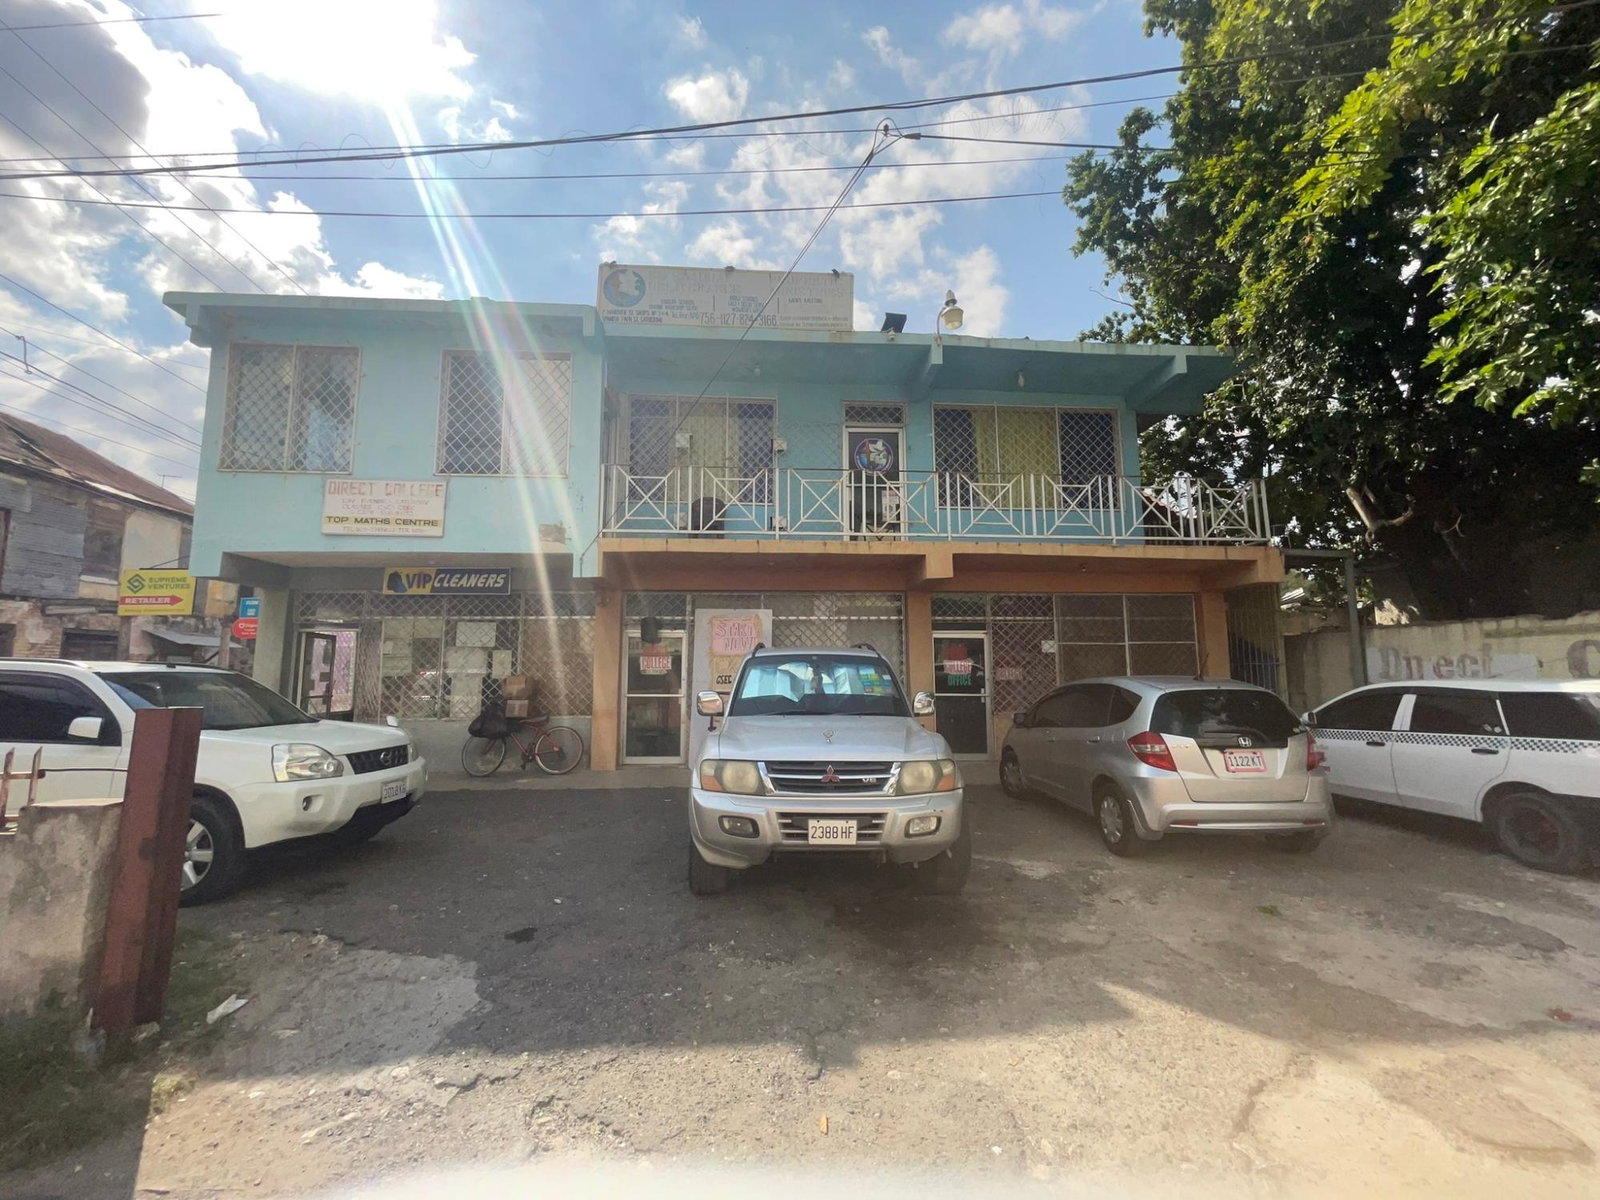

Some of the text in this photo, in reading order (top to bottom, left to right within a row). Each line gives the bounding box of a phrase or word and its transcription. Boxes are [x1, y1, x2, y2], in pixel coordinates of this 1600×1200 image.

[739, 313, 777, 327] 8243166
[327, 481, 376, 497] DIRECT
[354, 517, 391, 525] MATHS
[394, 518, 439, 527] CENTRE
[406, 572, 507, 589] VIP CLEANERS
[810, 825, 855, 839] 2388 HF
